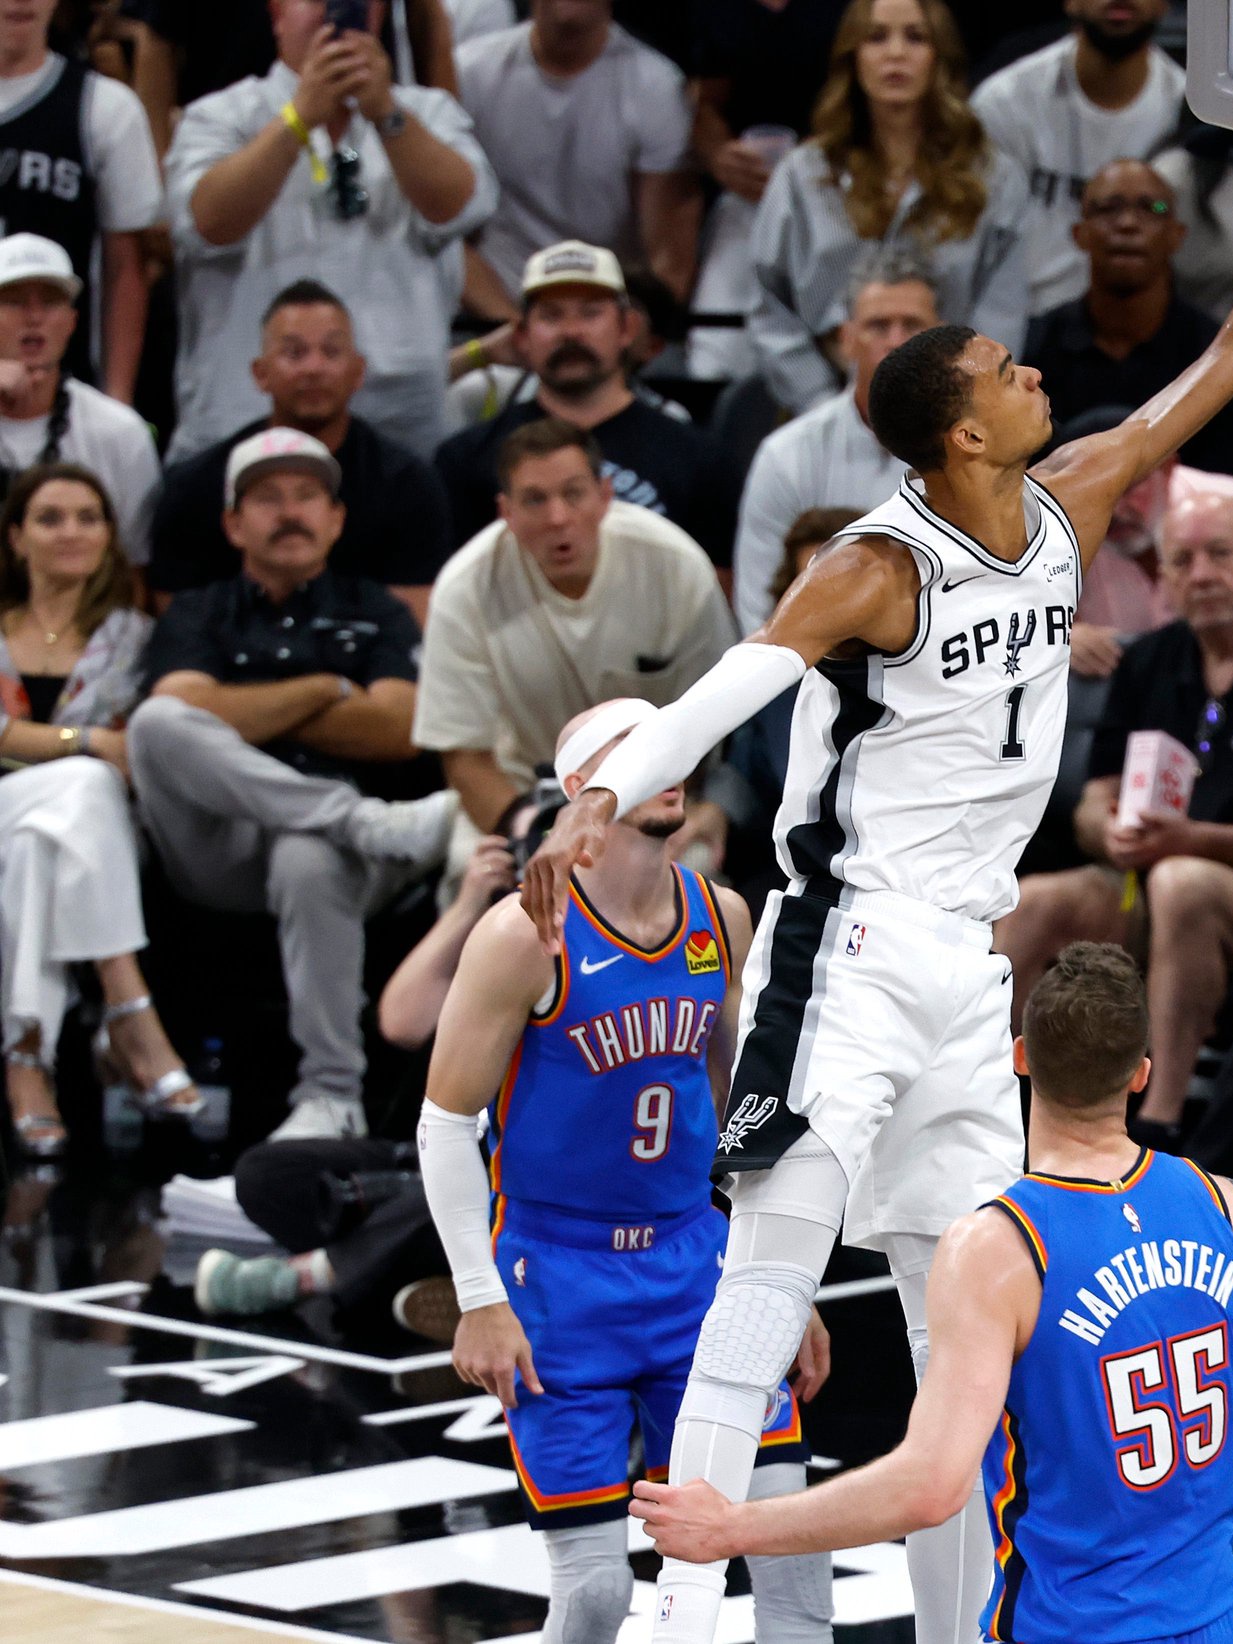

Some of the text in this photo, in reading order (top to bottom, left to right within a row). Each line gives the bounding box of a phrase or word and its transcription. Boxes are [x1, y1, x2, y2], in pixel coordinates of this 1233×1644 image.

[1048, 562, 1070, 577] LEDGER
[999, 682, 1027, 762] 1
[566, 996, 719, 1075] THUNDE
[629, 1081, 675, 1164] 9
[611, 1225, 656, 1251] OKC
[1099, 1319, 1229, 1493] 55
